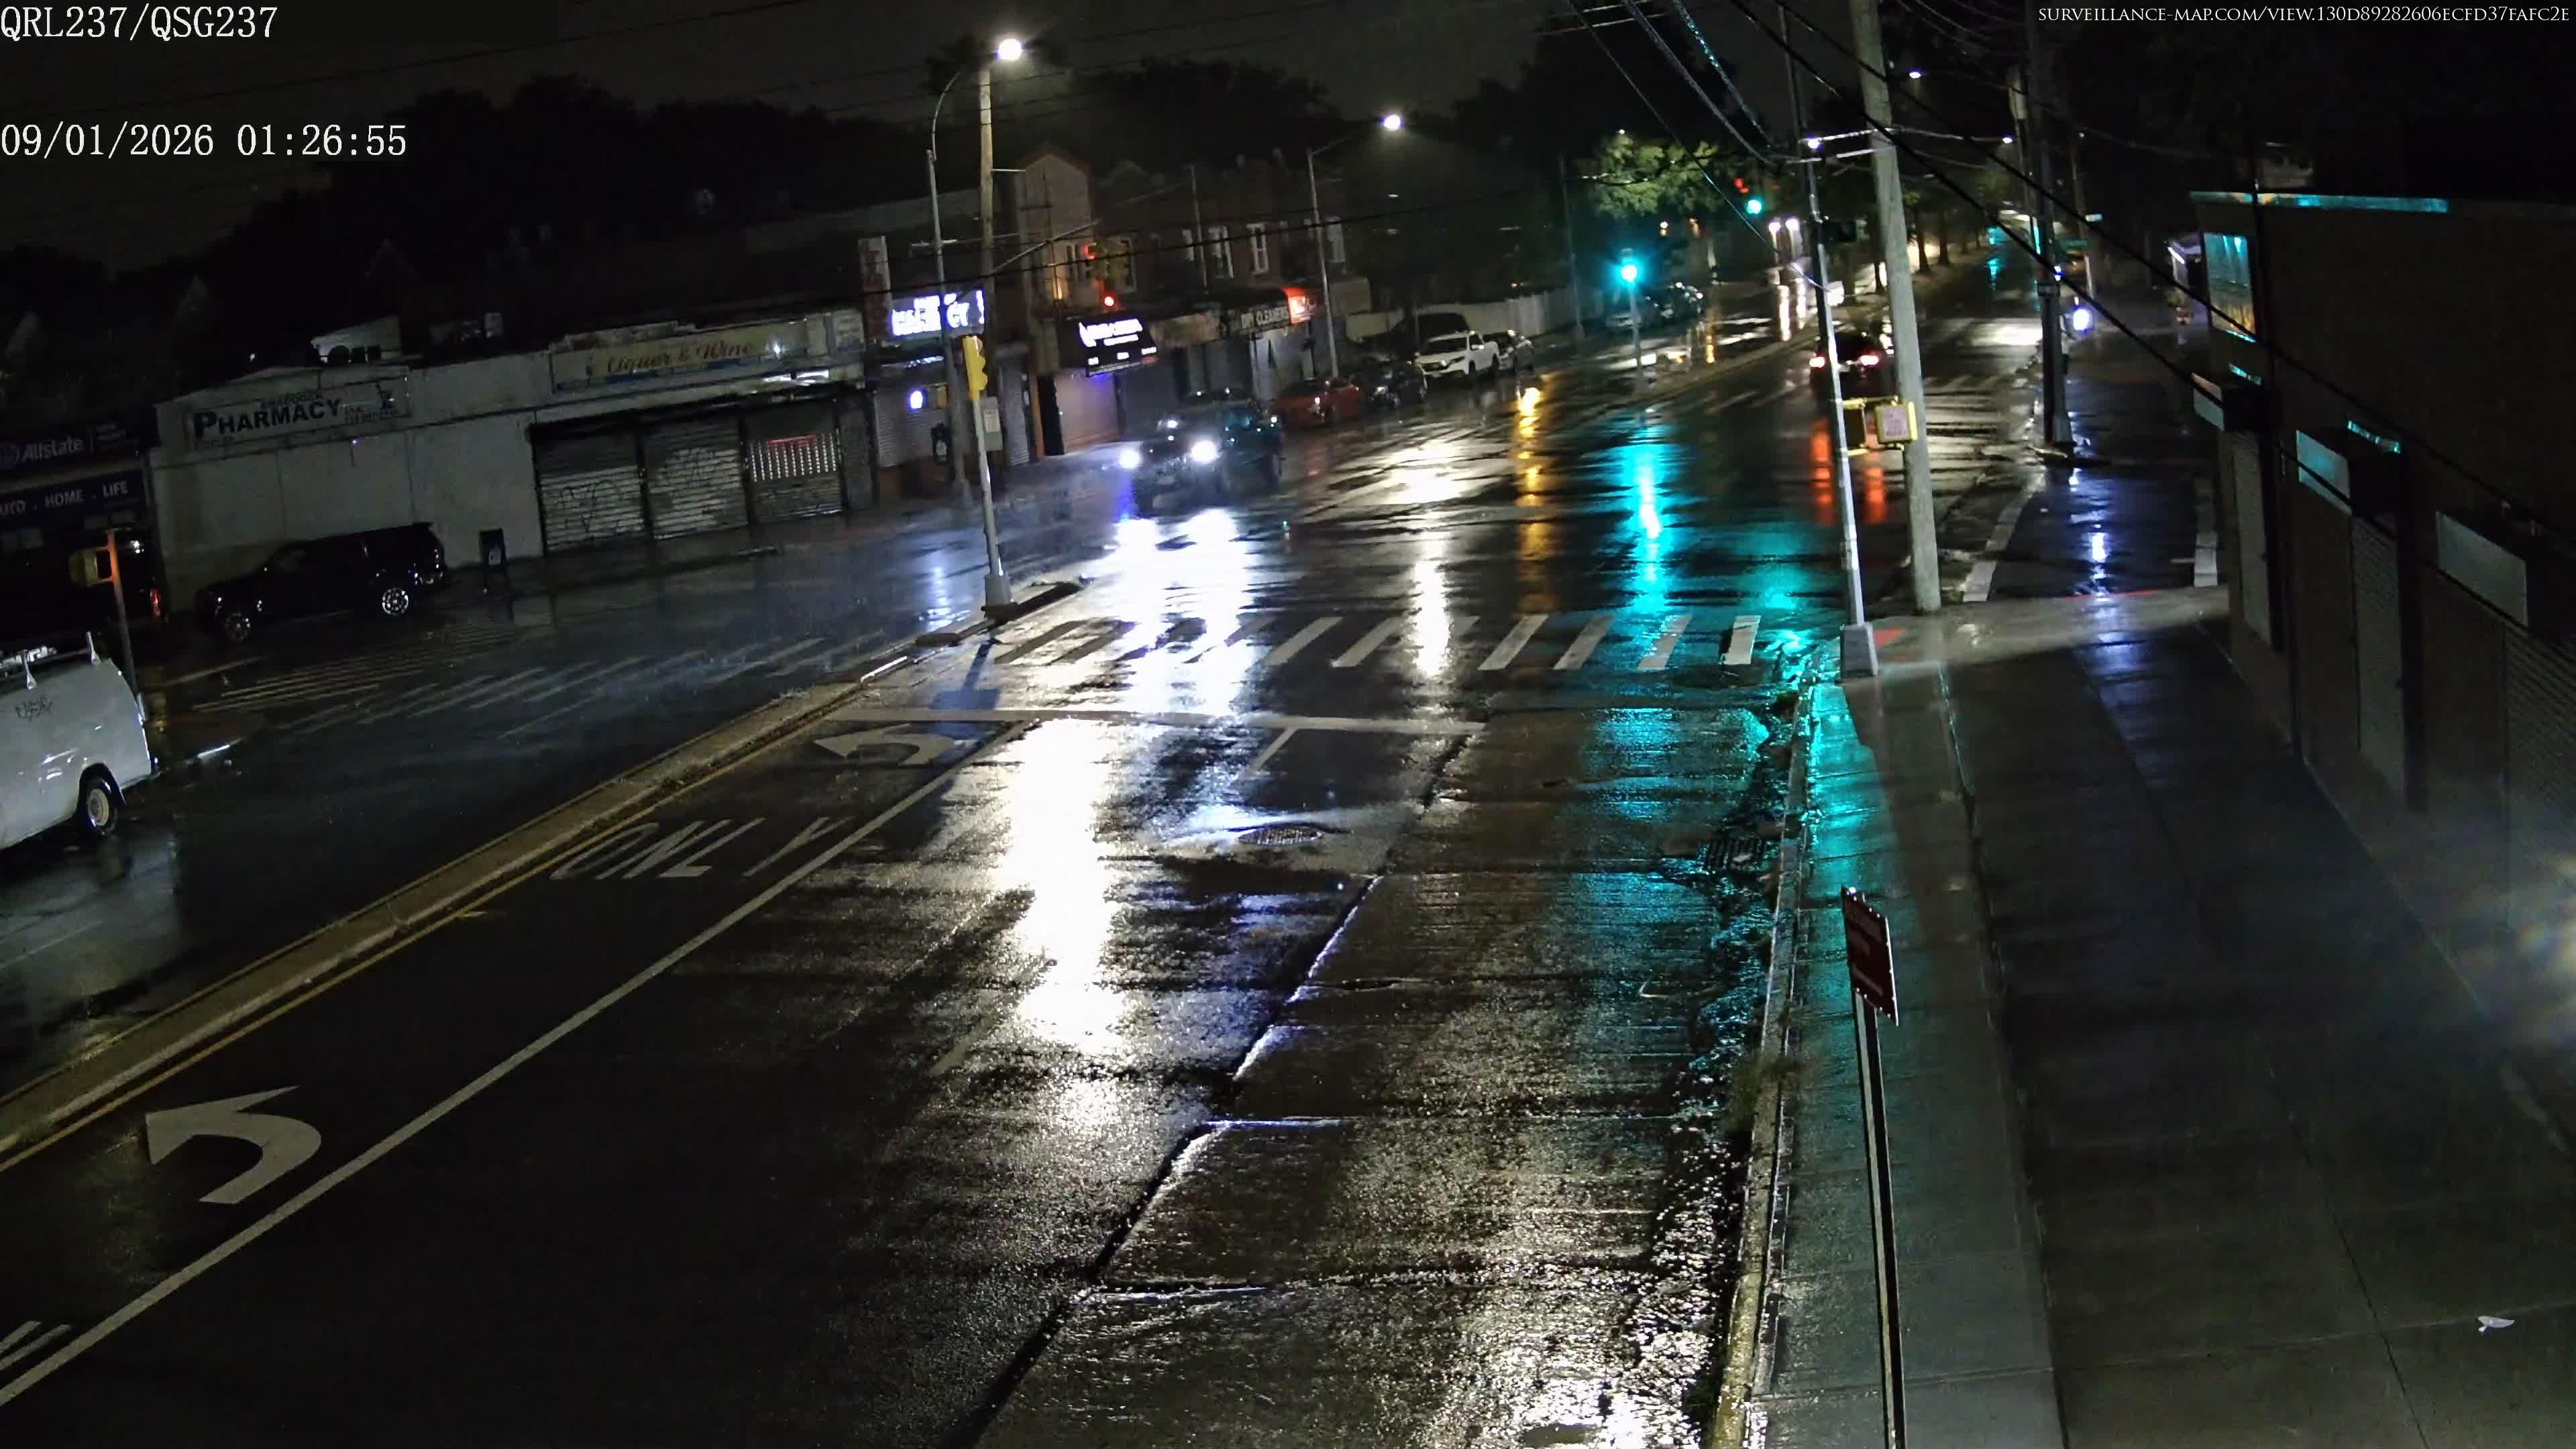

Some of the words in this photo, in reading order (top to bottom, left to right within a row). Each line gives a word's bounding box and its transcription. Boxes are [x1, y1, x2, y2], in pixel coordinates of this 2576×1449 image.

[193, 398, 341, 439] PHARMACY
[21, 437, 84, 462] Allstate
[44, 489, 85, 509] HOME
[102, 478, 129, 498] LIFE
